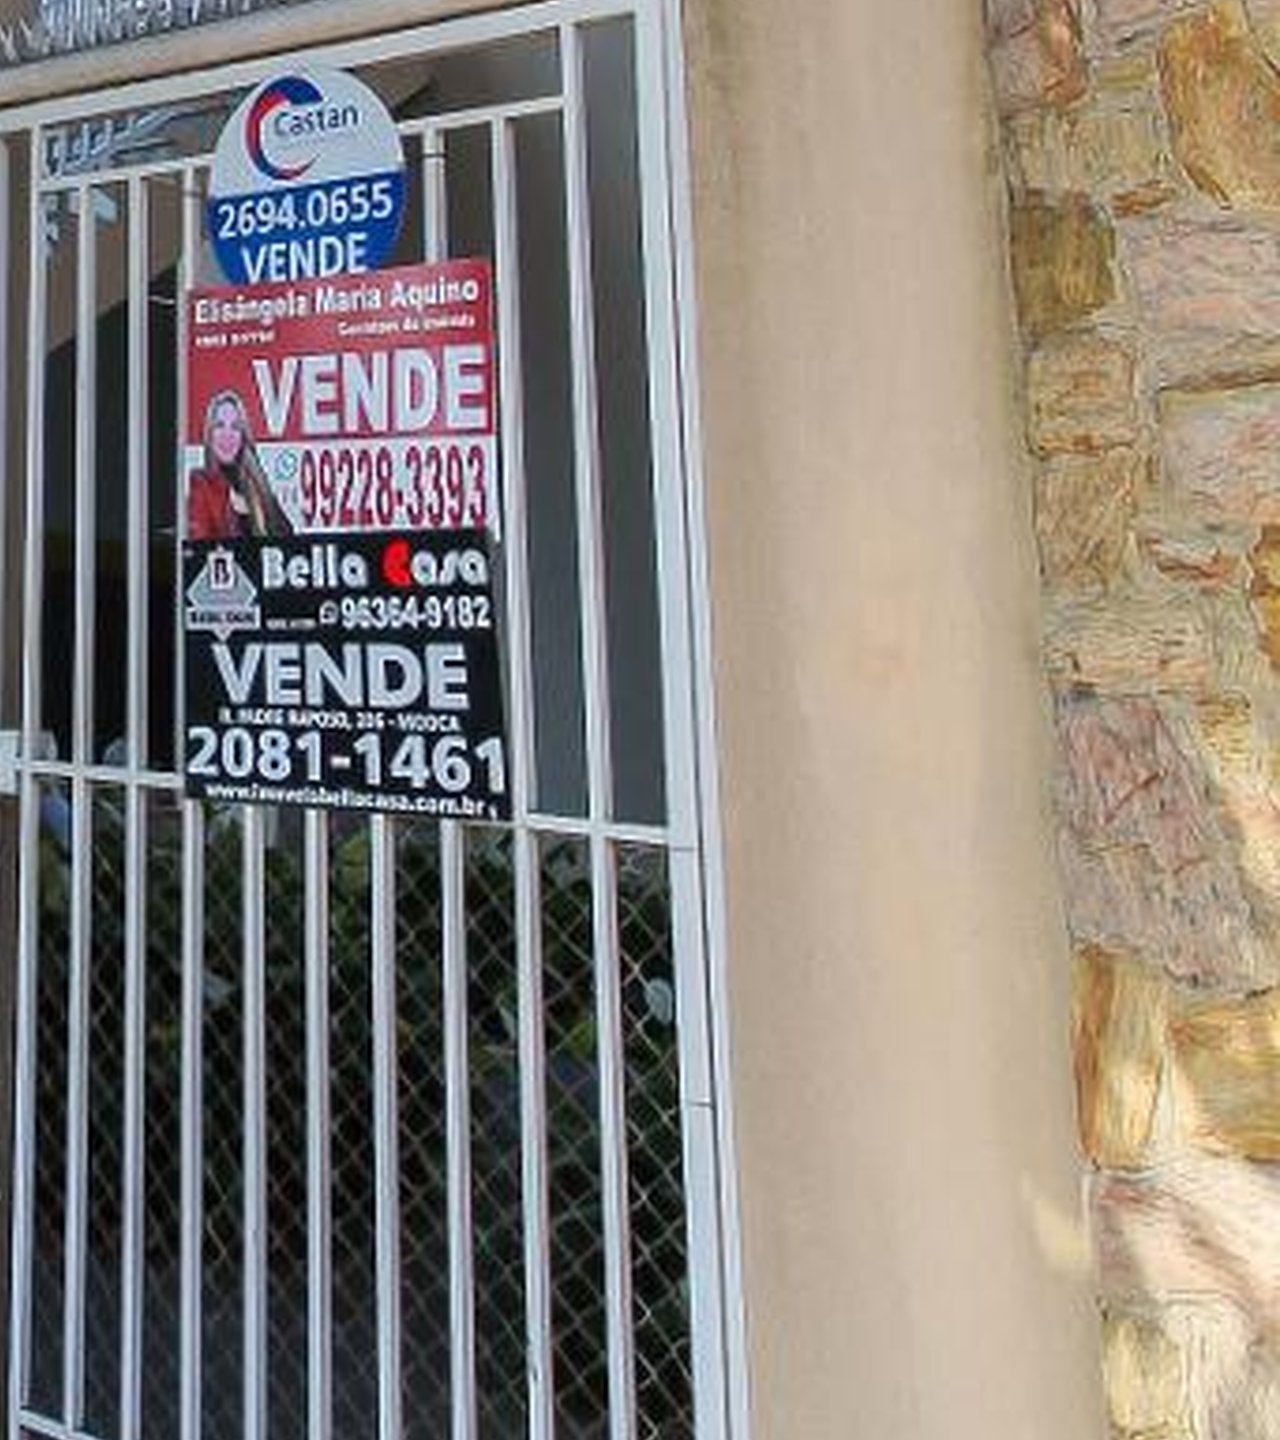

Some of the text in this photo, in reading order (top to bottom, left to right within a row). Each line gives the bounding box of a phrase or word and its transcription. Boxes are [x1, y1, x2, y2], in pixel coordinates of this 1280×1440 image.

[274, 105, 359, 136] Castan
[217, 181, 393, 239] 2694.0655
[242, 232, 368, 284] VENDE
[315, 284, 382, 314] Maria
[391, 277, 479, 312] Aquino
[252, 346, 487, 437] VENDE
[262, 538, 489, 590] Bella Casa
[211, 641, 470, 710] VENDE
[187, 726, 506, 794] 2081-1461
